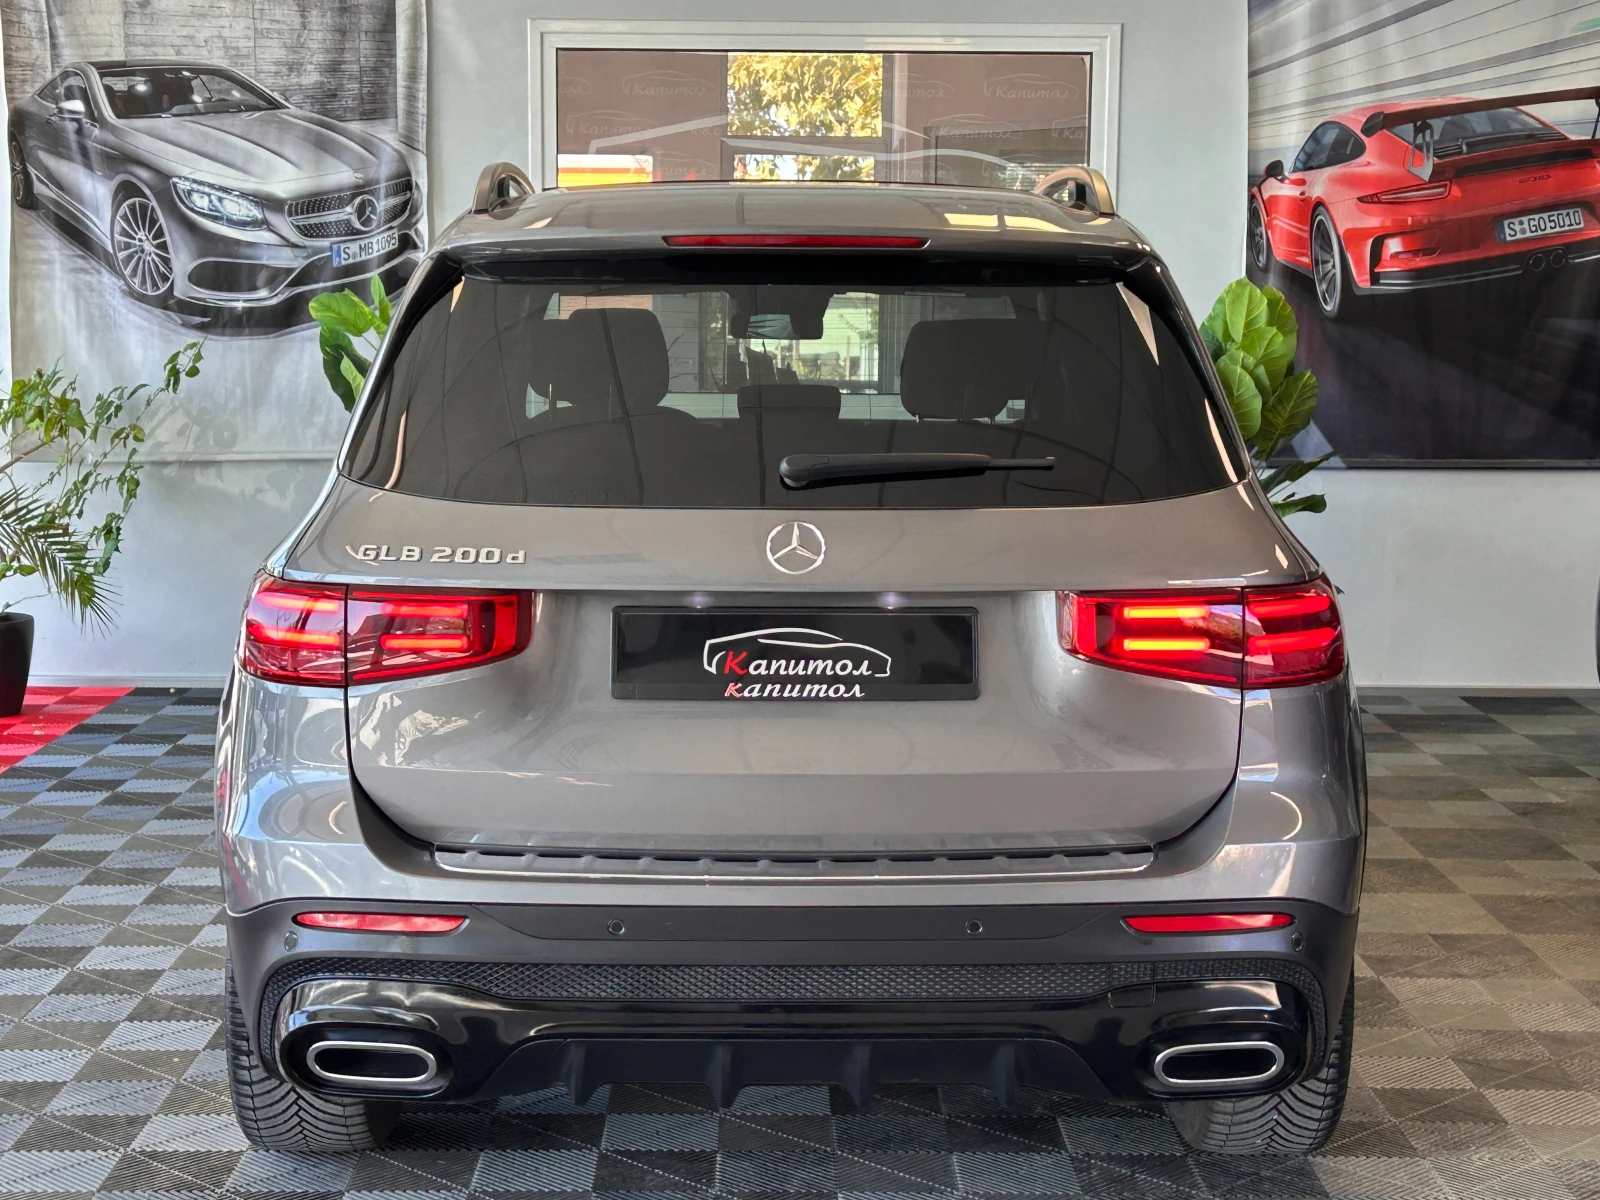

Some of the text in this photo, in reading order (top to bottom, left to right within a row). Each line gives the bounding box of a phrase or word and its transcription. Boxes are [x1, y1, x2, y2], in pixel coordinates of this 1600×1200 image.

[1507, 221, 1518, 238] S
[1548, 210, 1582, 230] 5010
[342, 232, 397, 261] S MB 1095
[358, 544, 422, 562] GLB
